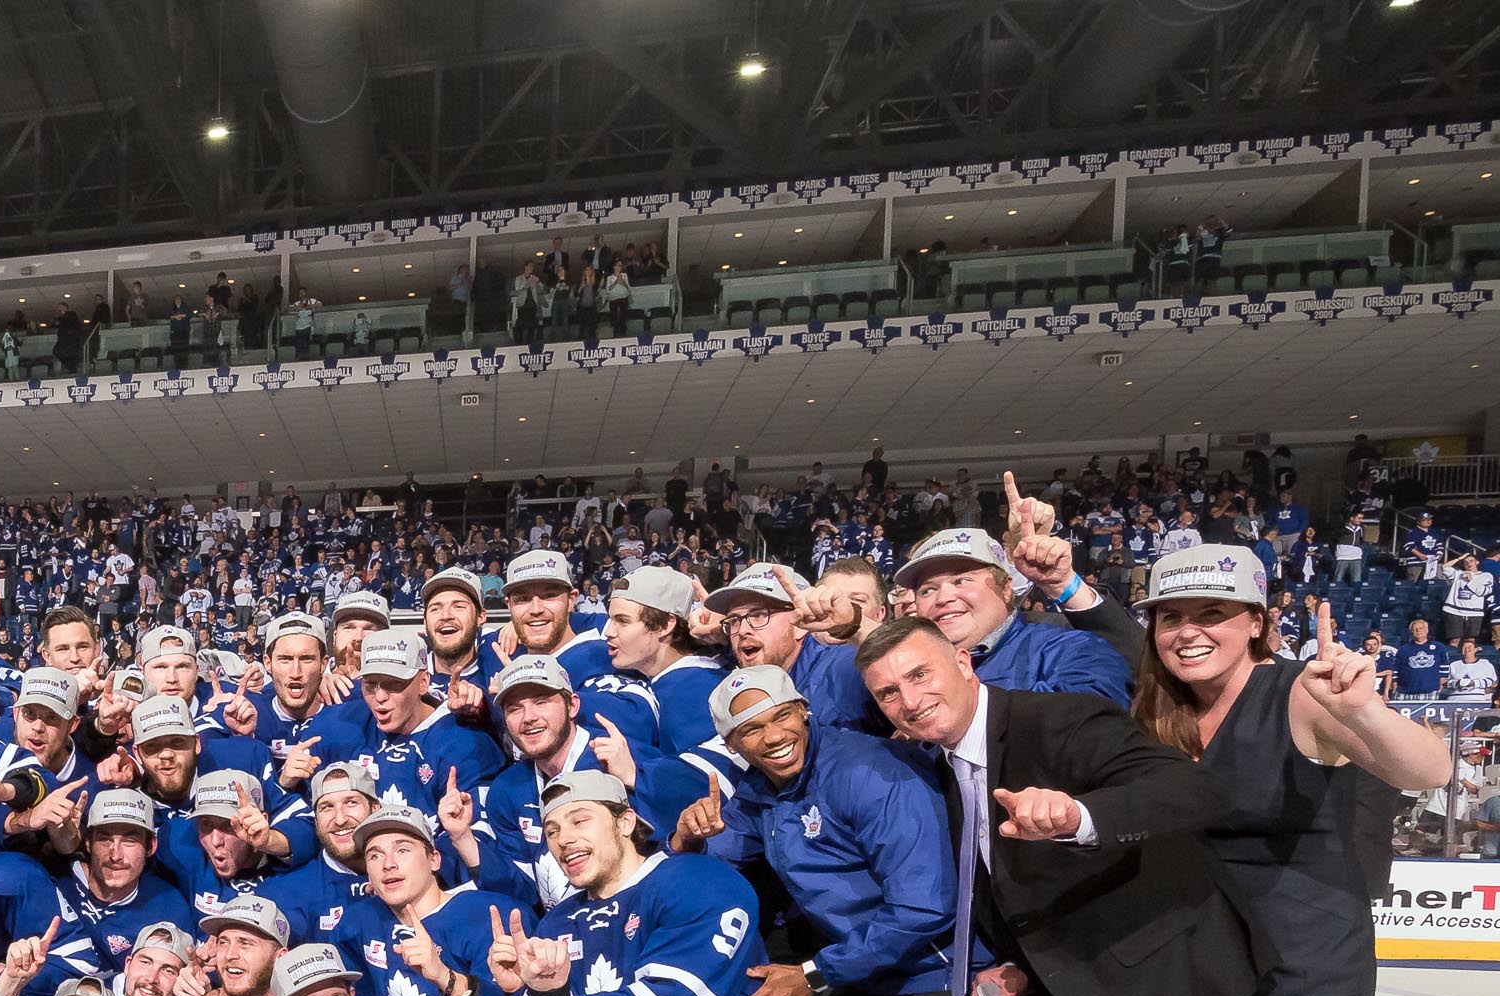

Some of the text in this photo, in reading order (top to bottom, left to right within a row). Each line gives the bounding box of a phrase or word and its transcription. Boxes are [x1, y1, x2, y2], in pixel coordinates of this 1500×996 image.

[1445, 122, 1482, 134] DEVANE
[1323, 133, 1350, 144] LEIVO
[1385, 129, 1413, 140] BROLL
[1194, 143, 1231, 155] McKEGG
[1256, 137, 1294, 150] D'AMIGO
[1327, 144, 1344, 152] 2013
[1080, 153, 1108, 164] PERCY
[1130, 148, 1176, 160] GRANBERG
[1204, 154, 1220, 163] 2014
[1266, 149, 1283, 158] 2013
[1022, 159, 1049, 170] KOZUN
[1085, 164, 1101, 172] 2014
[1144, 159, 1160, 167] 2014
[894, 169, 942, 181] MacWILLIAM
[956, 164, 992, 176] CARRICK
[1027, 170, 1043, 178] 2014
[795, 179, 826, 190] SPARKS
[849, 174, 879, 184] FROESE
[965, 175, 982, 183] 2014
[739, 185, 768, 196] LEIPSIC
[856, 184, 871, 192] 2015
[631, 194, 669, 205] NYLANDER
[691, 190, 711, 200] LOOV
[526, 205, 567, 216] SOSHNIKOV
[585, 200, 612, 210] HYMAN
[438, 214, 463, 225] VALIEV
[481, 209, 514, 220] KAPANEN
[338, 223, 371, 234] GAUTHIER
[391, 219, 417, 229] BROWN
[293, 227, 325, 238] LINDBERG
[1365, 294, 1420, 307] ORESKOVIC
[1439, 291, 1485, 303] ROSEHILL
[1241, 303, 1273, 315] BOZAK
[1296, 298, 1354, 311] GUNNARSSON
[1111, 311, 1142, 323] POGGE
[1170, 306, 1213, 319] DEVEAUX
[1314, 310, 1333, 319] 2009
[976, 319, 1020, 332] MITCHELL
[1045, 315, 1076, 327] SIFERS
[864, 328, 886, 339] EARL
[920, 325, 953, 335] FOSTER
[742, 336, 773, 347] TLUSTY
[802, 333, 829, 344] BOYCE
[625, 344, 665, 356] NEWBURY
[678, 340, 723, 352] STRALMAN
[521, 353, 551, 365] WHITE
[571, 348, 612, 361] WILLIAMS
[1104, 356, 1119, 364] 101
[425, 361, 455, 371] ONDRUS
[477, 358, 498, 368] BELL
[310, 367, 351, 379] KRONWALL
[368, 364, 408, 375] HARRISON
[213, 376, 233, 387] BERG
[254, 371, 293, 383] GOVEDARIS
[111, 382, 139, 393] CIMETTA
[155, 379, 193, 390] JOHNSTON
[71, 386, 92, 395] ZEZEL
[1173, 565, 1198, 576] CALDER
[1200, 565, 1215, 573] CUP
[1159, 572, 1236, 590] CHAMPIONS
[1371, 883, 1500, 911] herT
[712, 907, 750, 960] 9
[297, 957, 315, 968] CALDER
